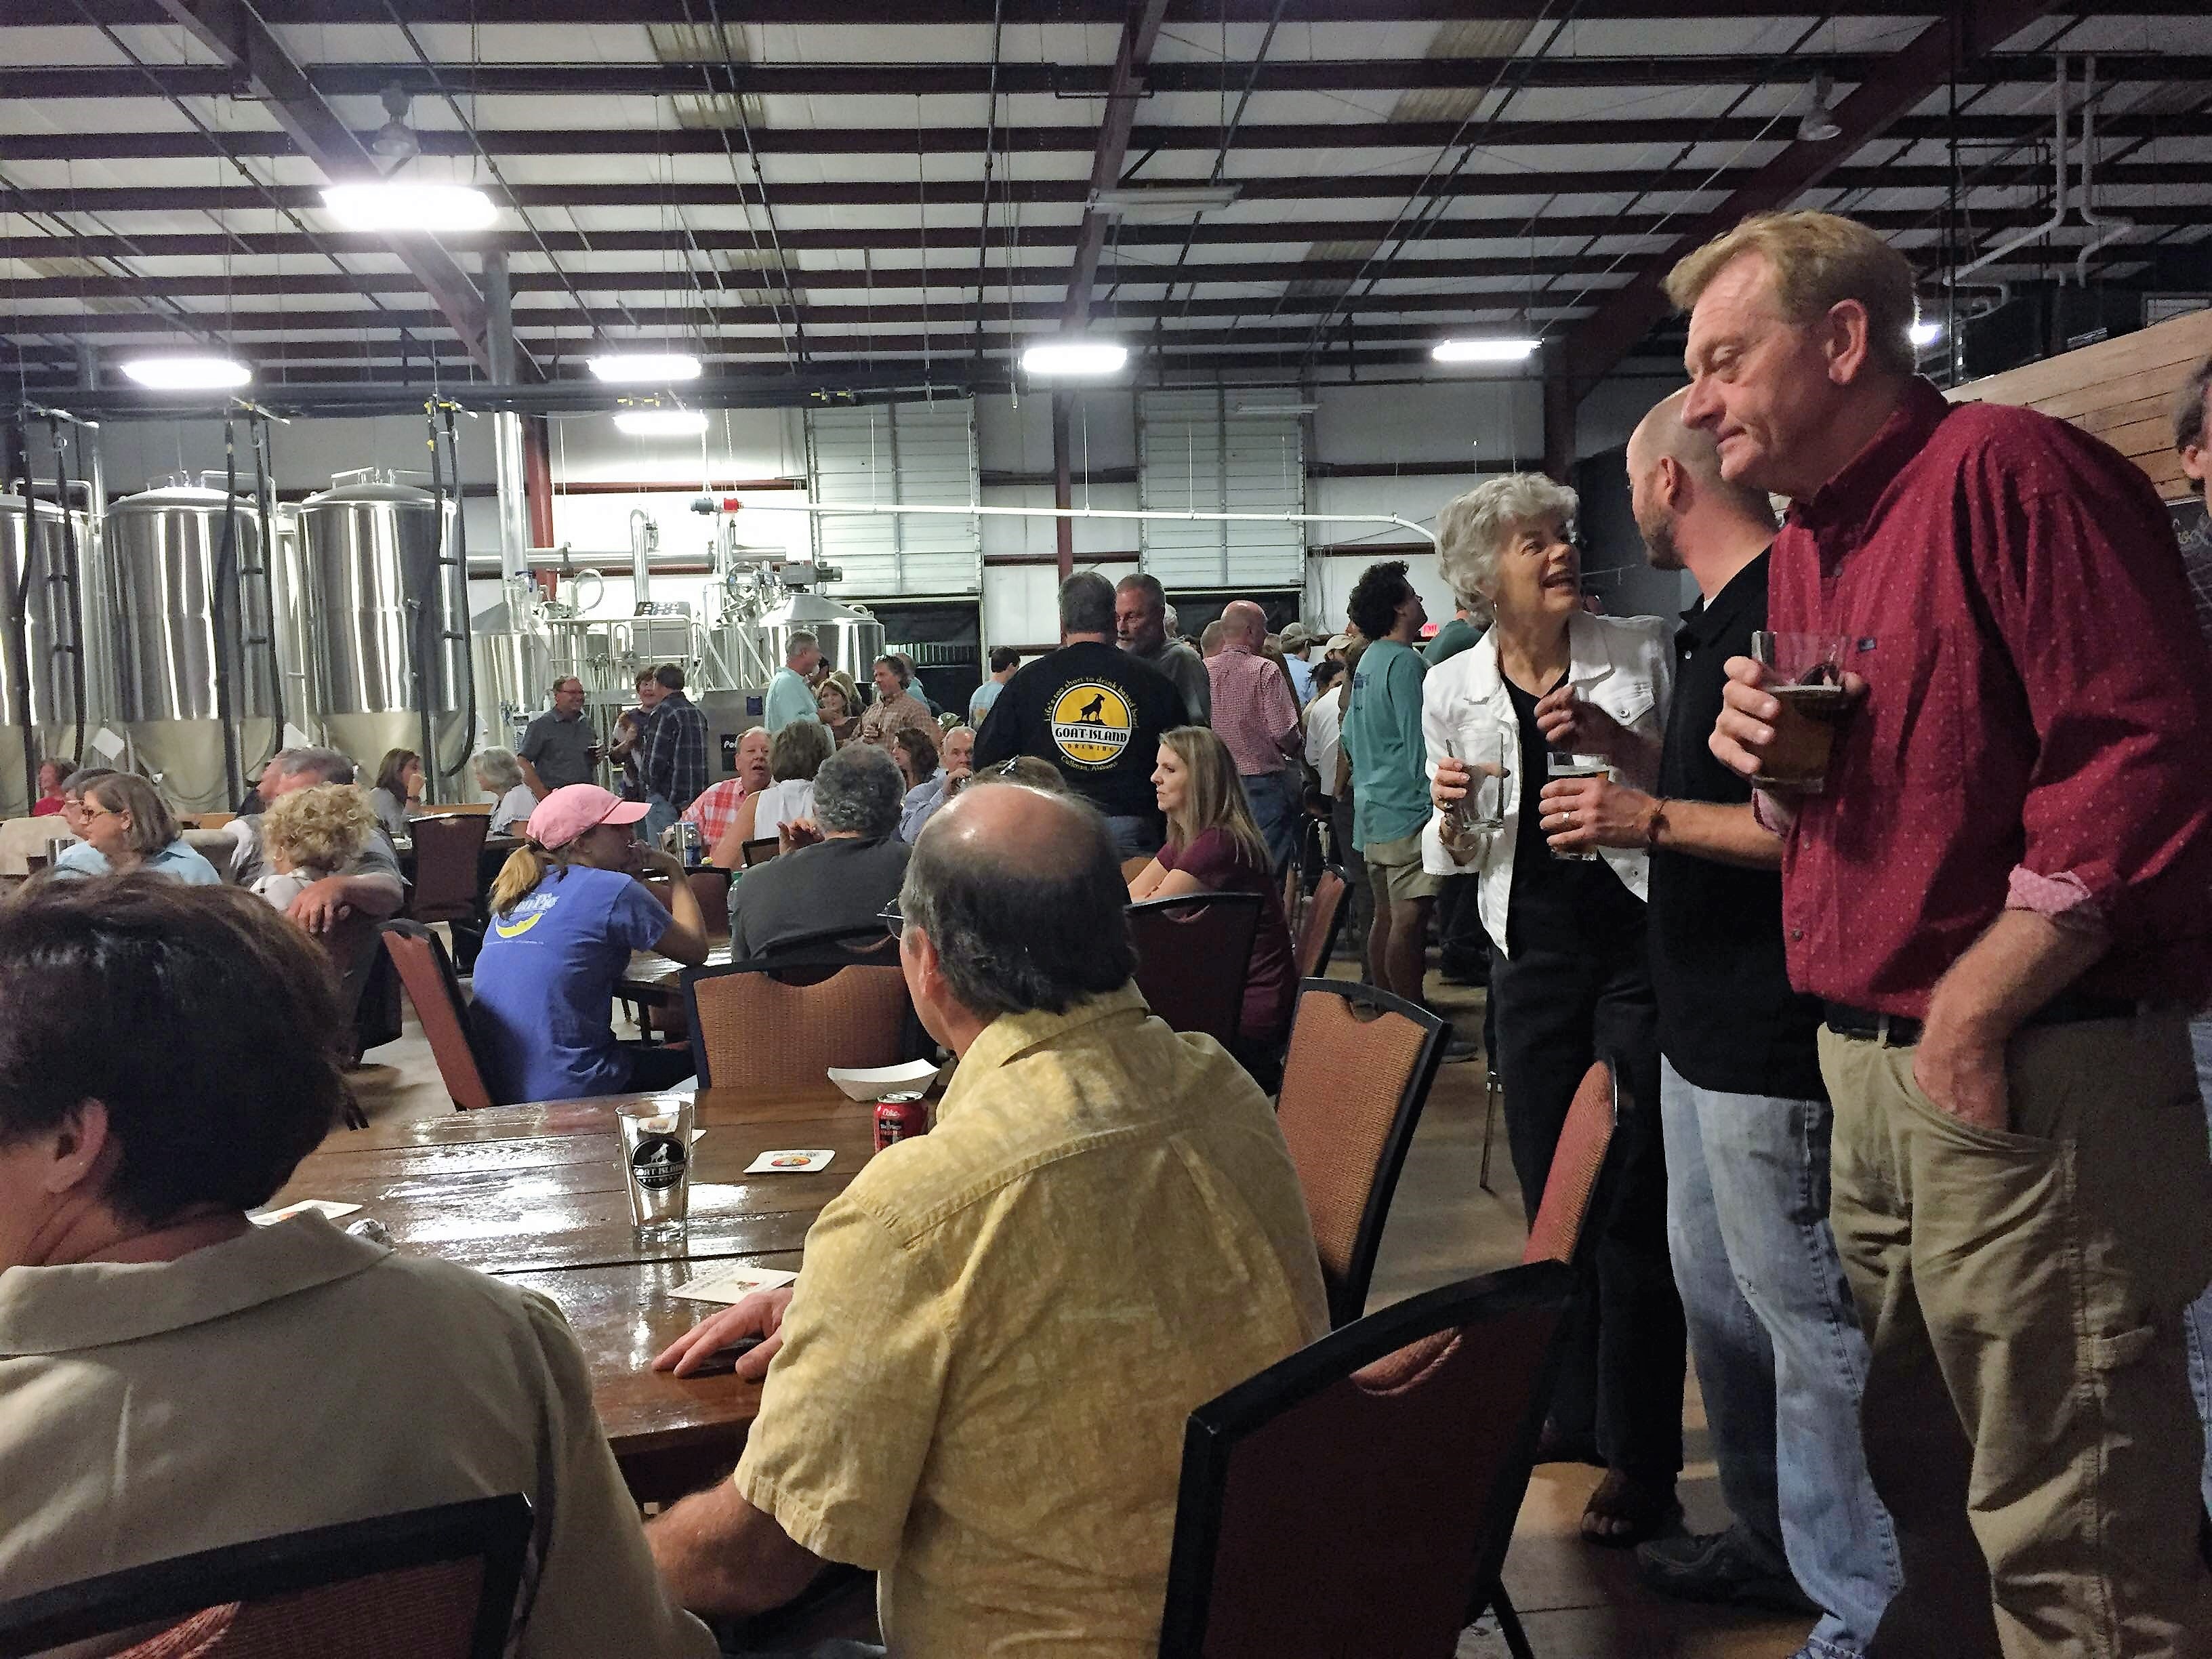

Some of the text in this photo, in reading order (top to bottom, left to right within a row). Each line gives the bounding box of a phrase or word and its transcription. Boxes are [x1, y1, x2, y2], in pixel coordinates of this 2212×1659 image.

[1053, 687, 1064, 699] too
[1096, 677, 1117, 689] drink
[1055, 728, 1127, 742] GOAT ISLAND
